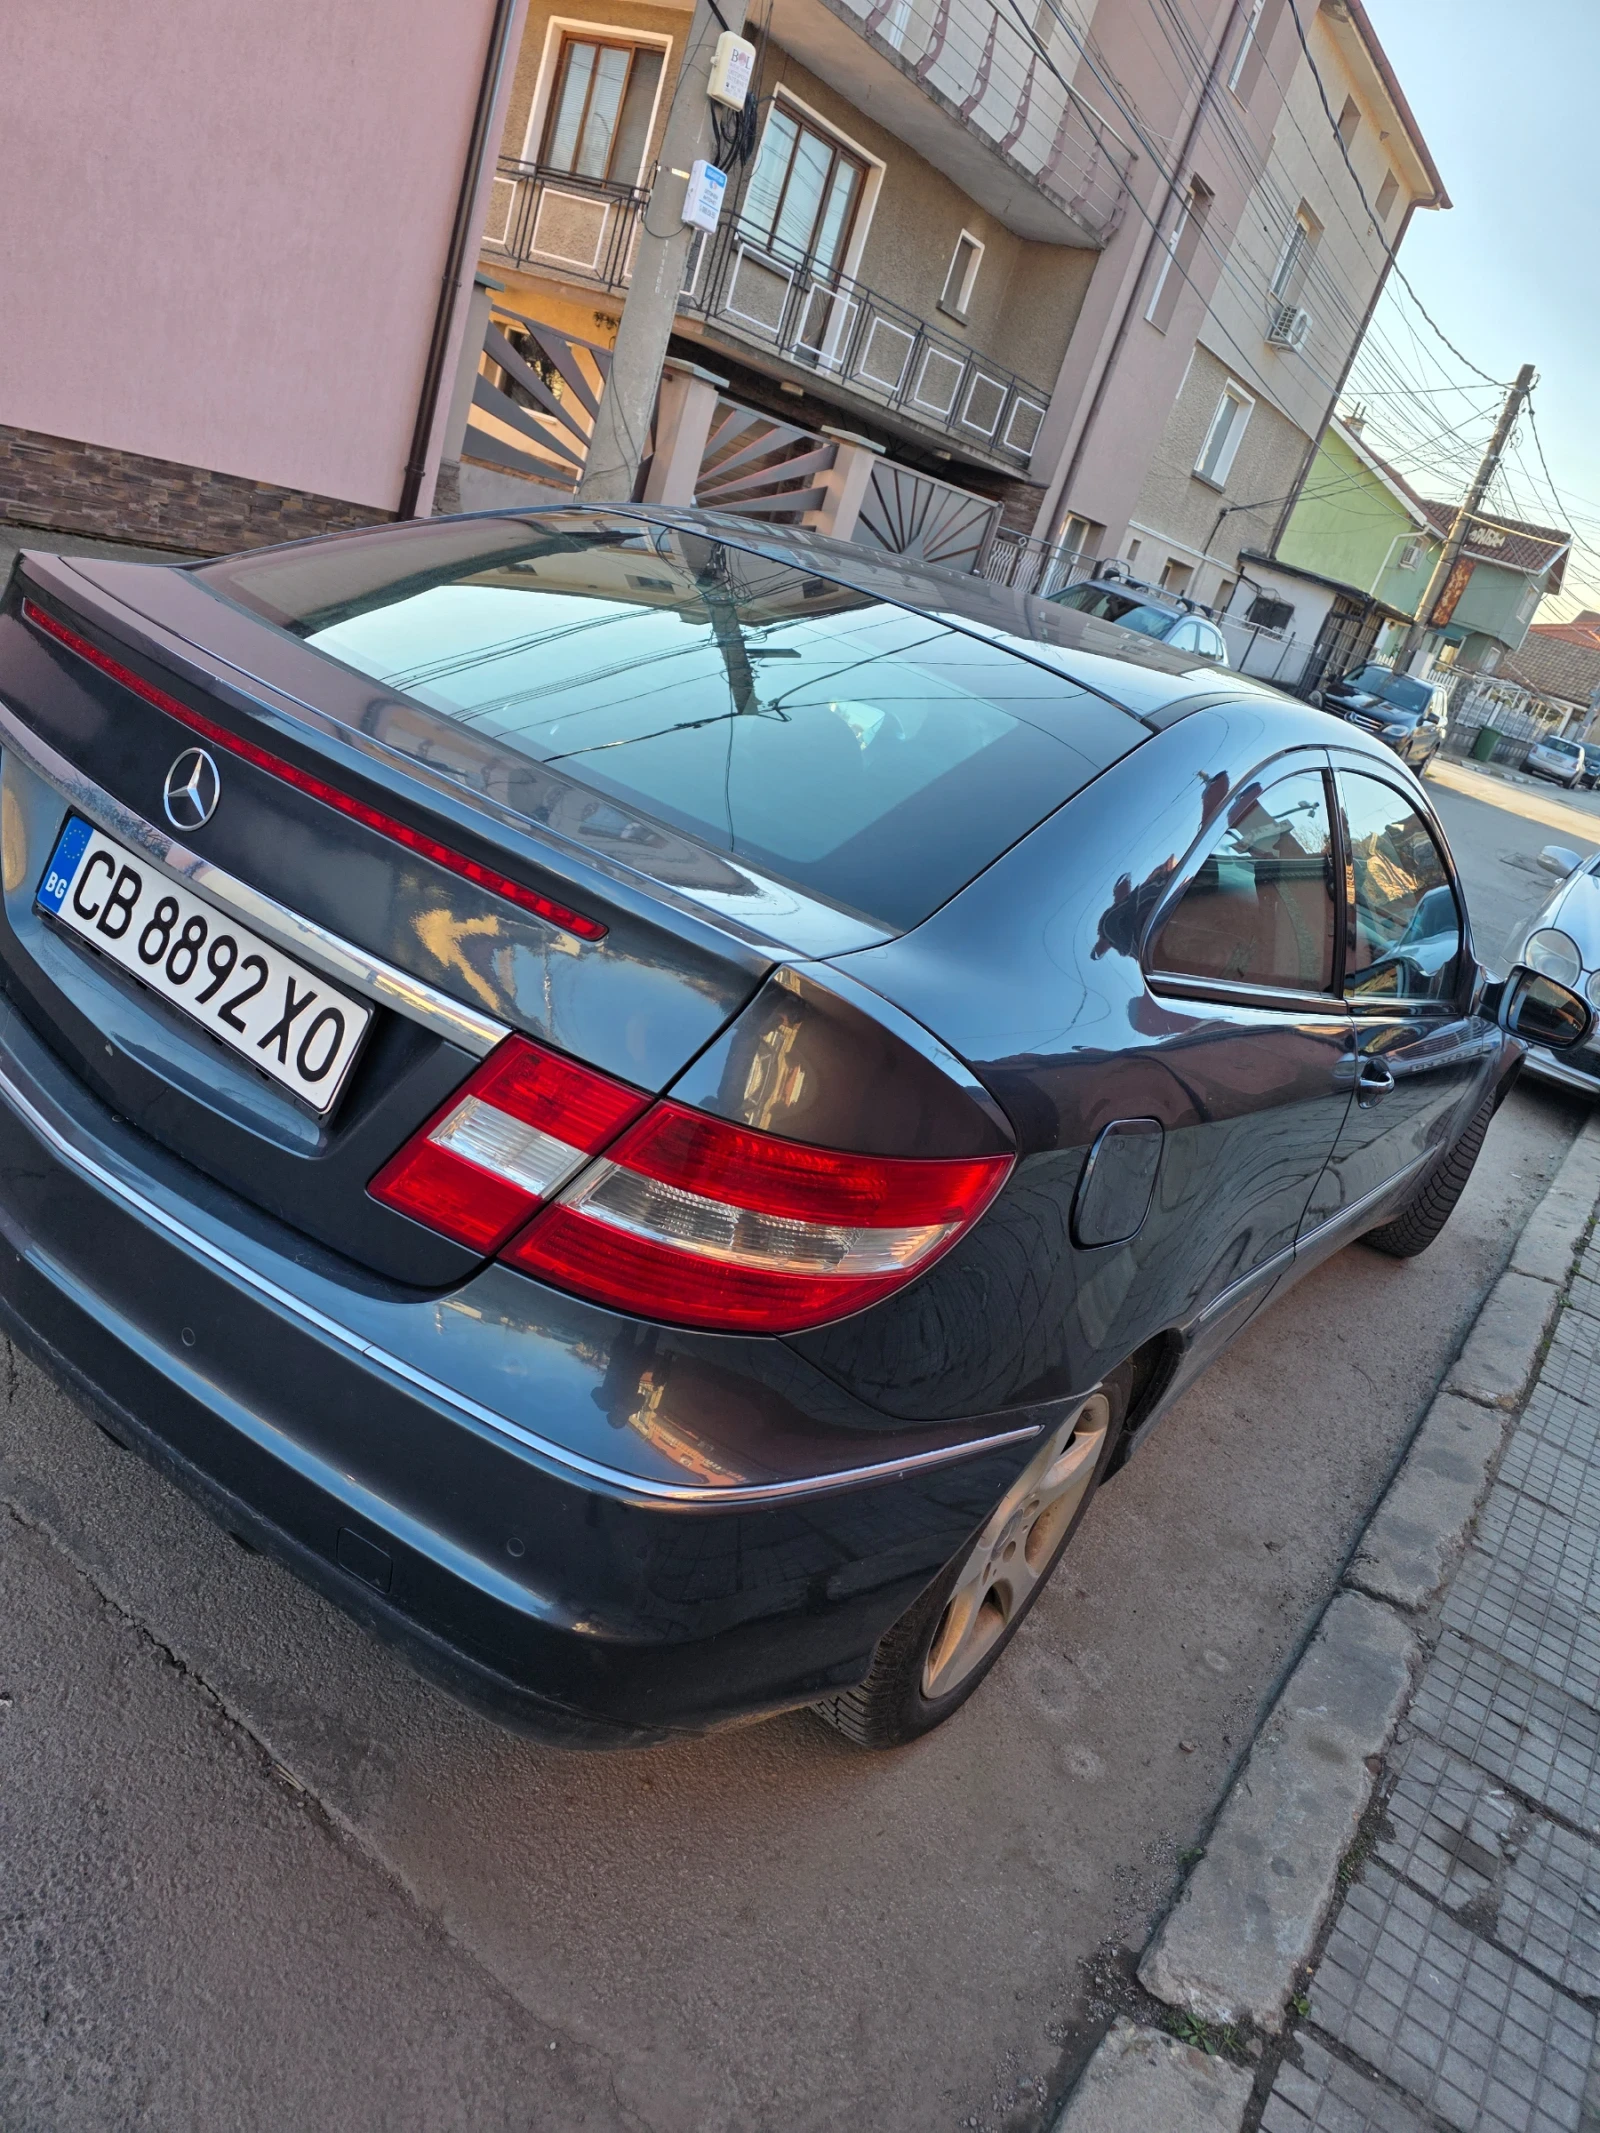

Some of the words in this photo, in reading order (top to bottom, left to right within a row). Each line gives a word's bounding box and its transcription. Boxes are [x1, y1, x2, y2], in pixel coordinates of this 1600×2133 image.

[44, 872, 67, 898] BG
[72, 849, 142, 940] CB
[137, 896, 269, 1034] 8892
[256, 976, 347, 1083] XO
